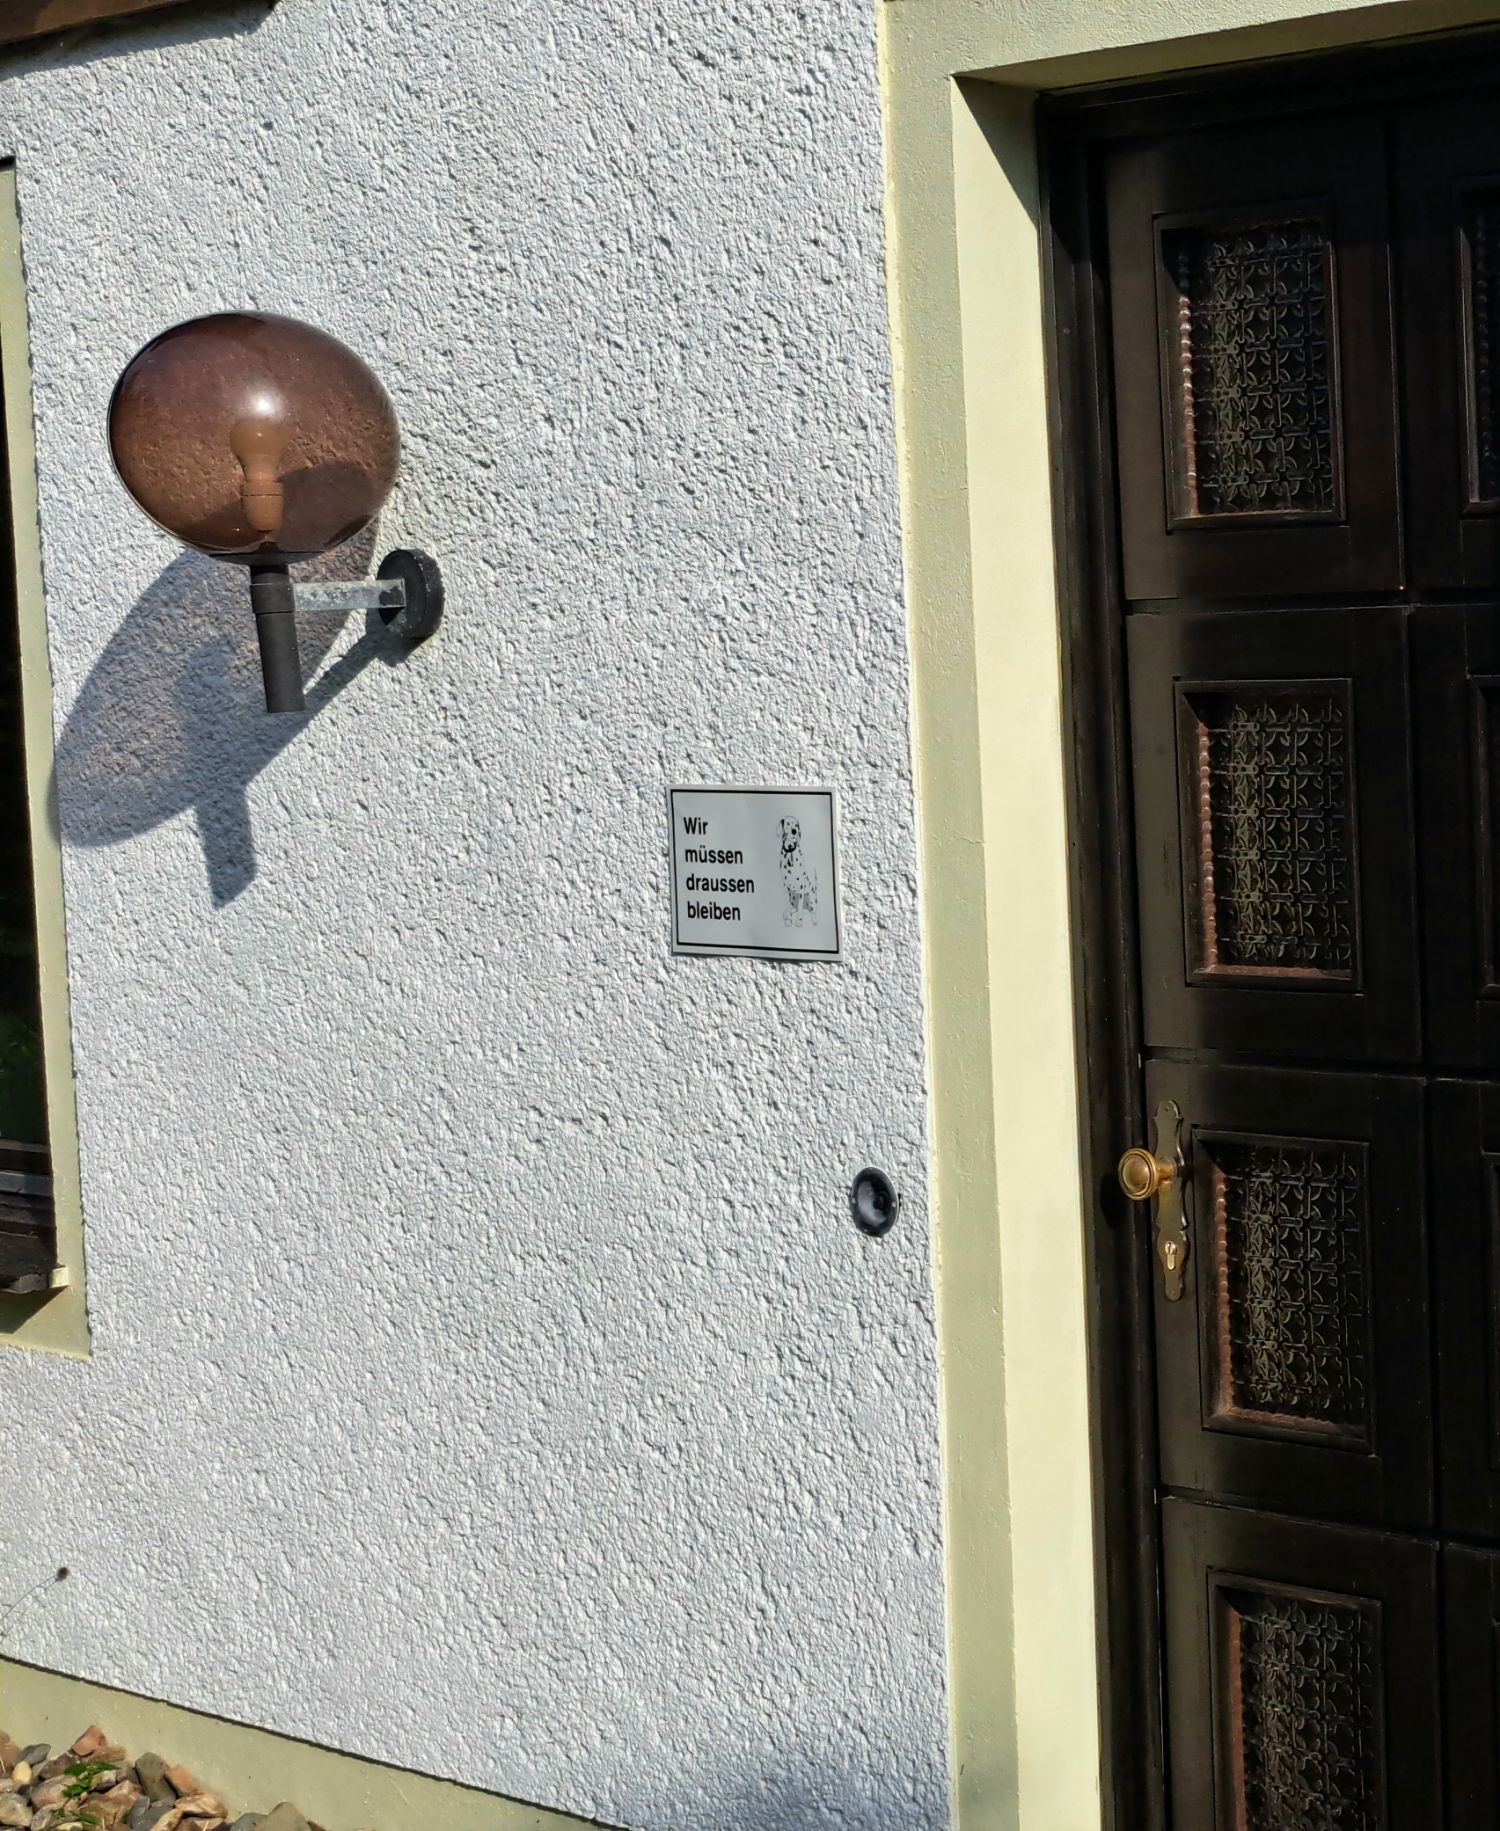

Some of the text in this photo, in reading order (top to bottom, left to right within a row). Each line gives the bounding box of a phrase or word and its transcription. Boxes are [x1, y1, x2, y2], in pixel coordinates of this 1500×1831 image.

[683, 817, 708, 835] Wir
[685, 845, 743, 864] müssen
[686, 873, 755, 893] draussen
[687, 901, 741, 920] bleiben
